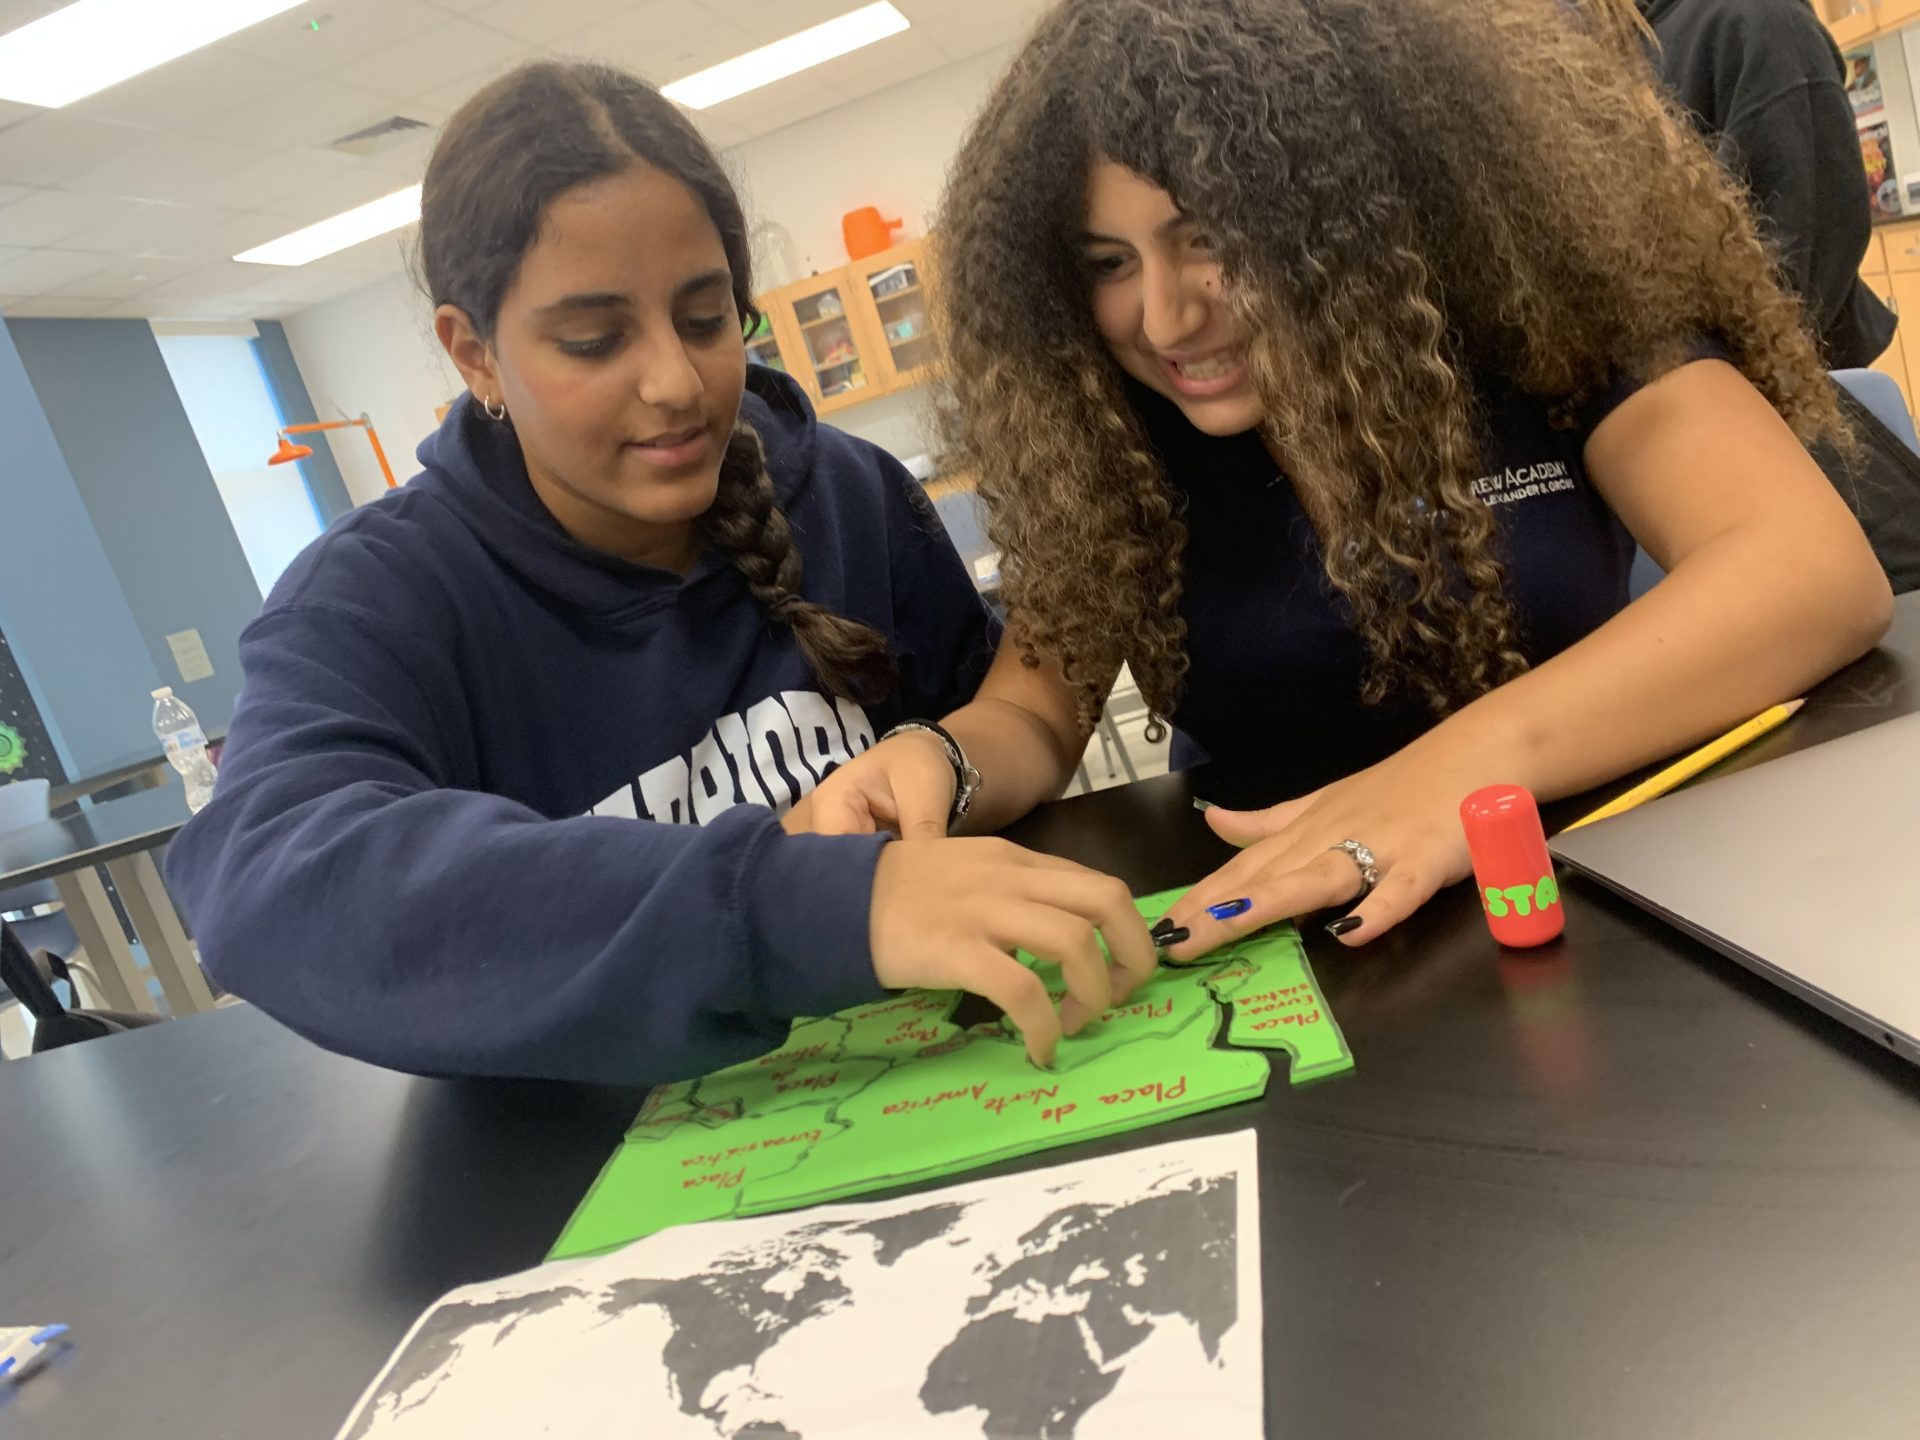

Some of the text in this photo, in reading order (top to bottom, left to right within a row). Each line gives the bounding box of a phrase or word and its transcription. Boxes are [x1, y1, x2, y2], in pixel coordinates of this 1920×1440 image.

[1471, 460, 1568, 496] REW ACADEMY
[1482, 486, 1539, 506] LEXANDER
[582, 690, 877, 828] RRIOR
[1485, 875, 1558, 917] STA
[1101, 997, 1173, 1024] Placa
[1251, 1008, 1319, 1031] Placa
[776, 1071, 840, 1093] Placa
[882, 1081, 1059, 1116] Norte América
[1041, 1076, 1186, 1123] Placa de
[682, 1167, 745, 1190] Placa
